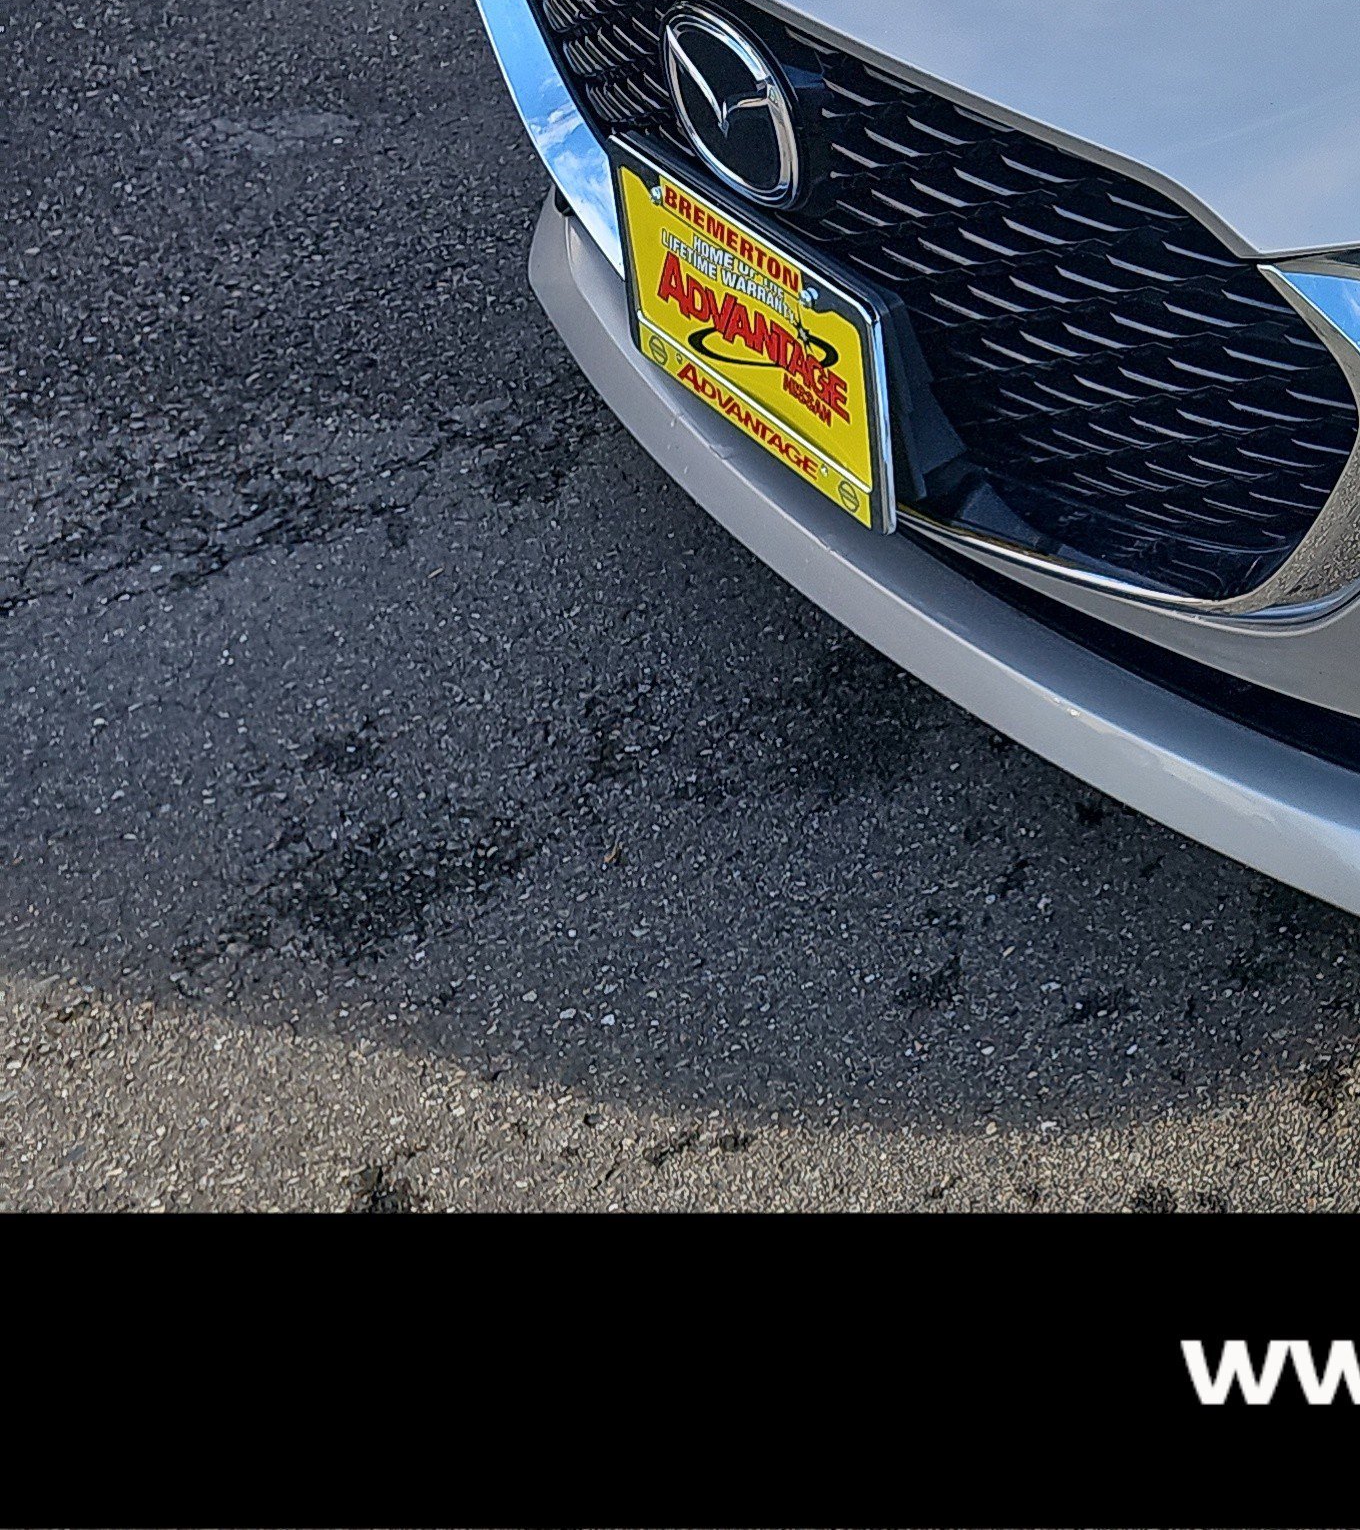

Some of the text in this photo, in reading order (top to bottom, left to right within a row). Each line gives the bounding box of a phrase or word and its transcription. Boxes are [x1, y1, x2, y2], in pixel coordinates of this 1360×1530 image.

[661, 228, 718, 282] LIFETIME
[664, 183, 800, 293] BREMERTON
[693, 233, 735, 271] HOME
[657, 250, 851, 425] ADVANTAGE
[676, 362, 818, 481] ADVANTAGE
[782, 371, 832, 428] NISSAN
